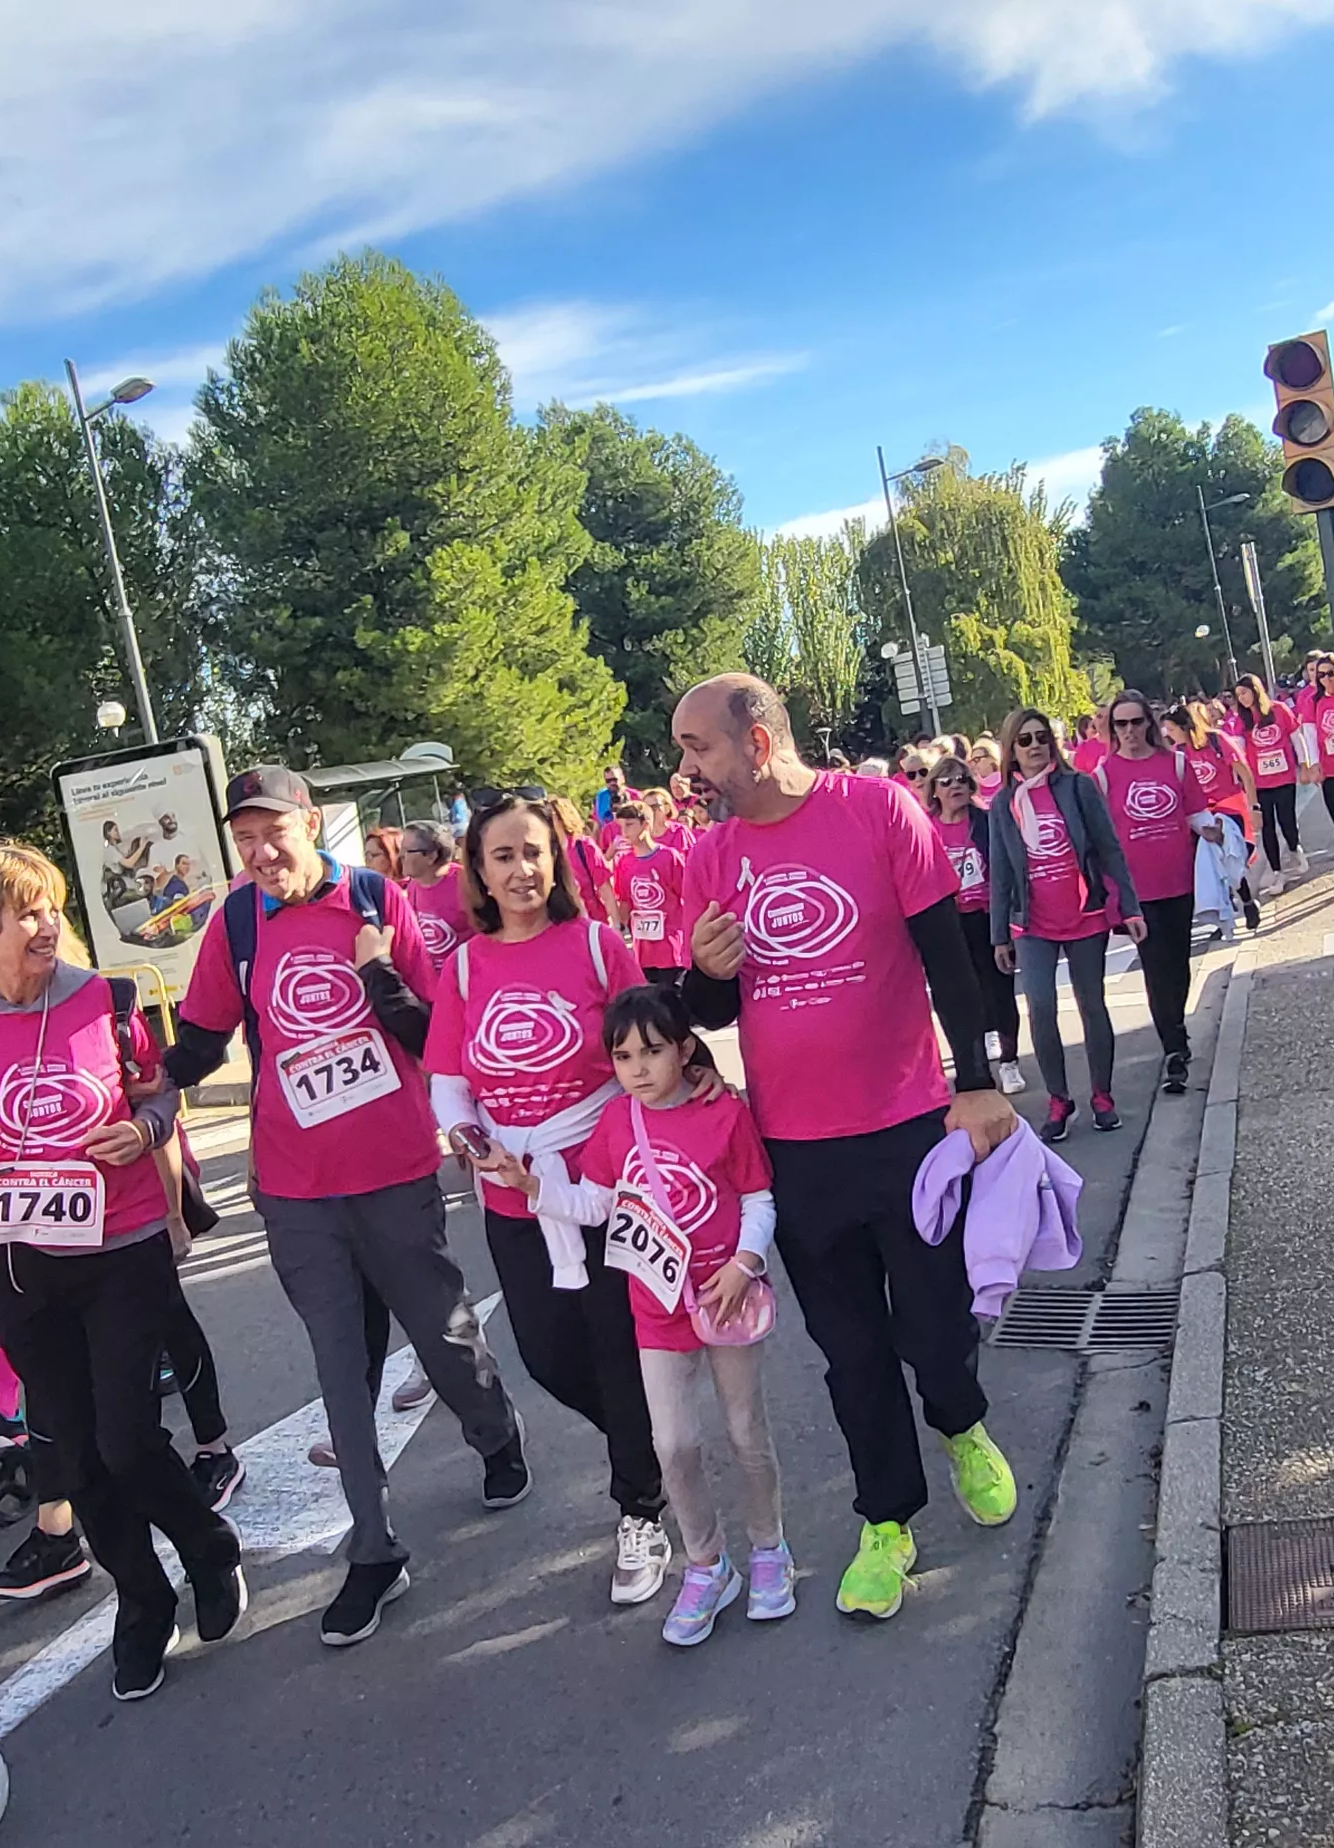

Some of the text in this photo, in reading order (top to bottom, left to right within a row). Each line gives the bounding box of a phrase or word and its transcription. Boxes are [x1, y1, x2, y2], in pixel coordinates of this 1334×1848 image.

[296, 1046, 381, 1101] 1734
[39, 1178, 50, 1187] EL
[51, 1176, 92, 1187] CÁNCER
[610, 1213, 680, 1284] 2076
